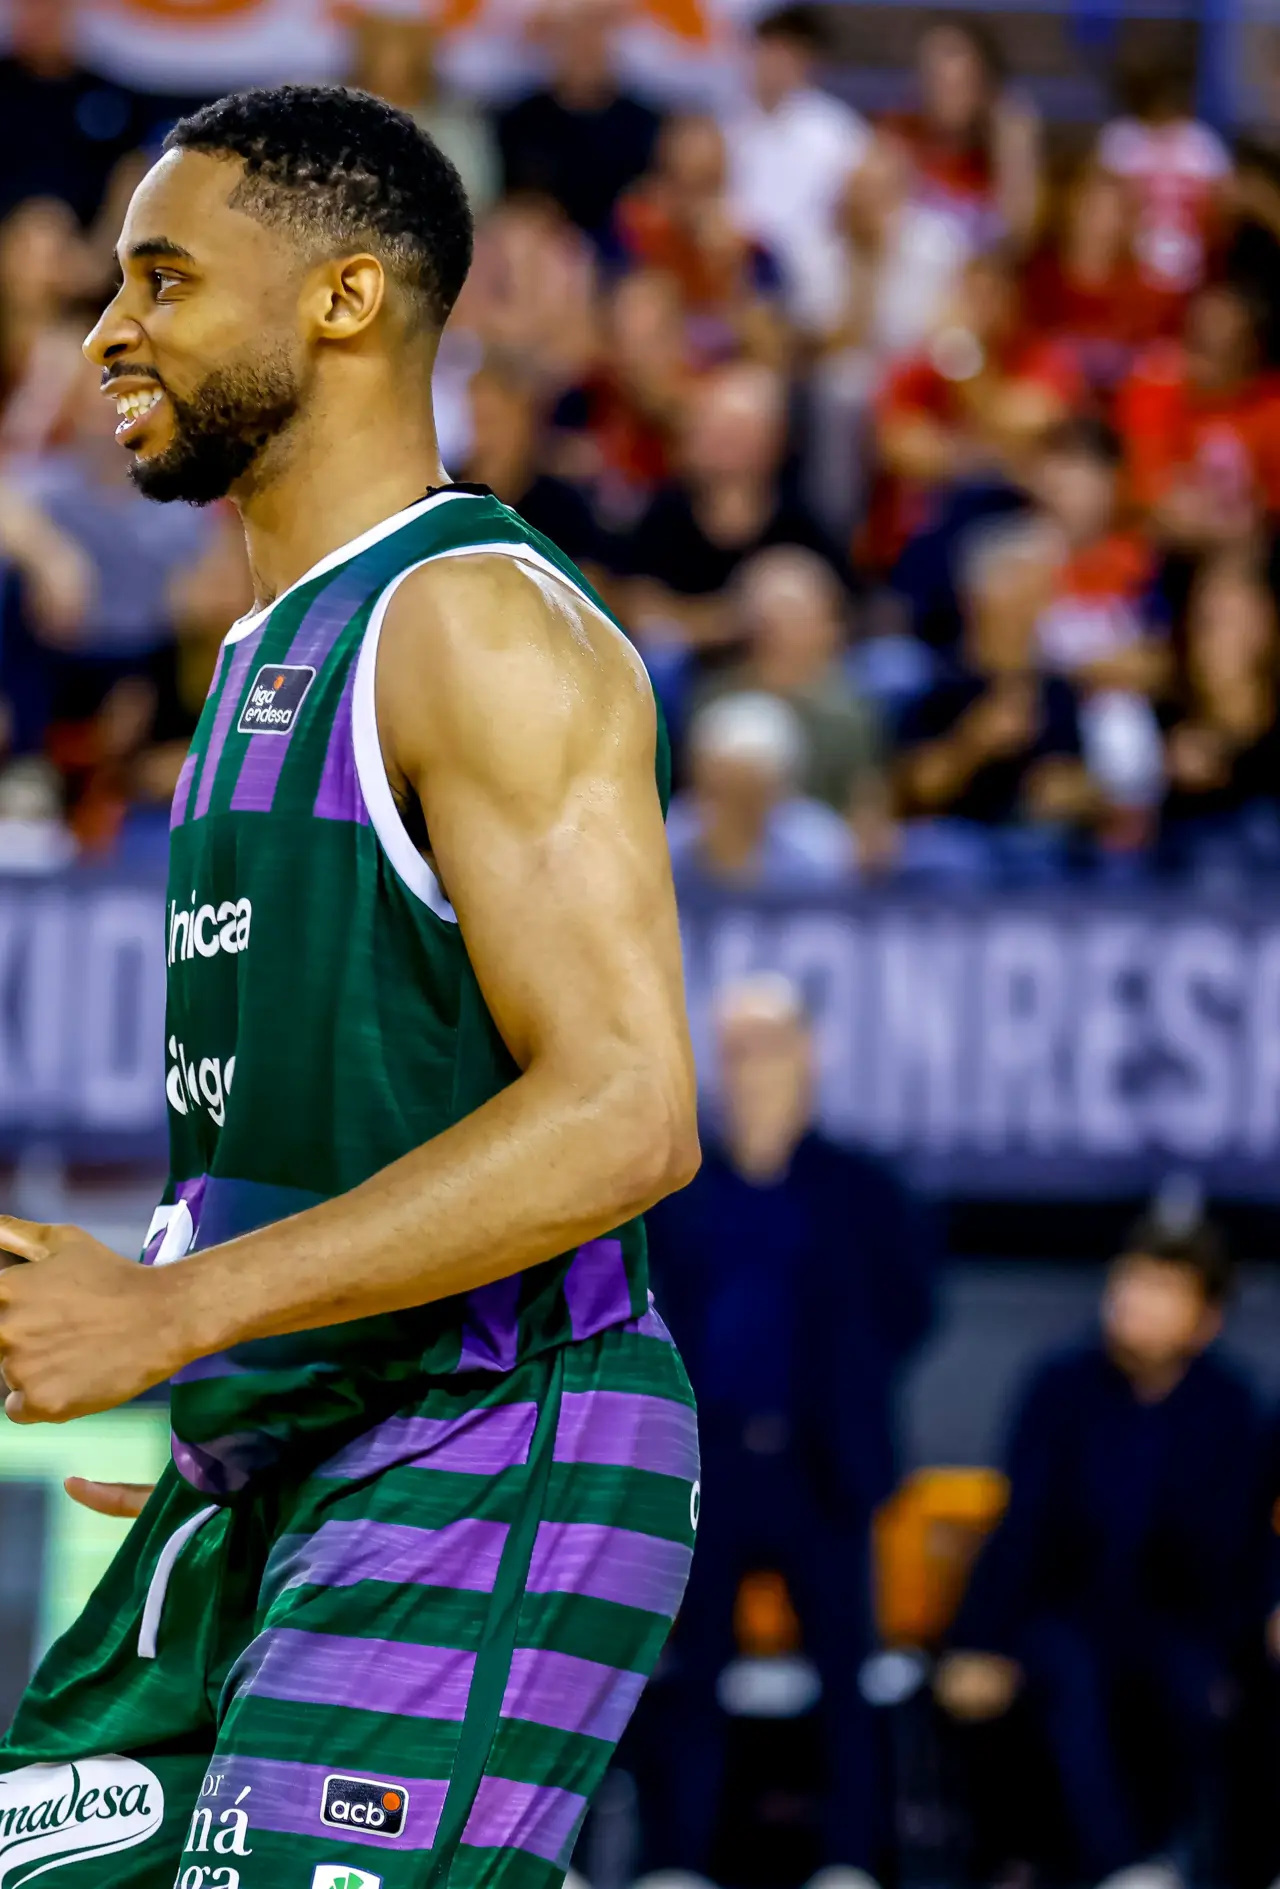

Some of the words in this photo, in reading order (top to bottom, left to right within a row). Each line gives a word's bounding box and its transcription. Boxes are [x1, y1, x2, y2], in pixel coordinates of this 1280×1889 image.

[251, 685, 276, 706] liga
[245, 705, 293, 724] endesa
[330, 1800, 385, 1826] acb
